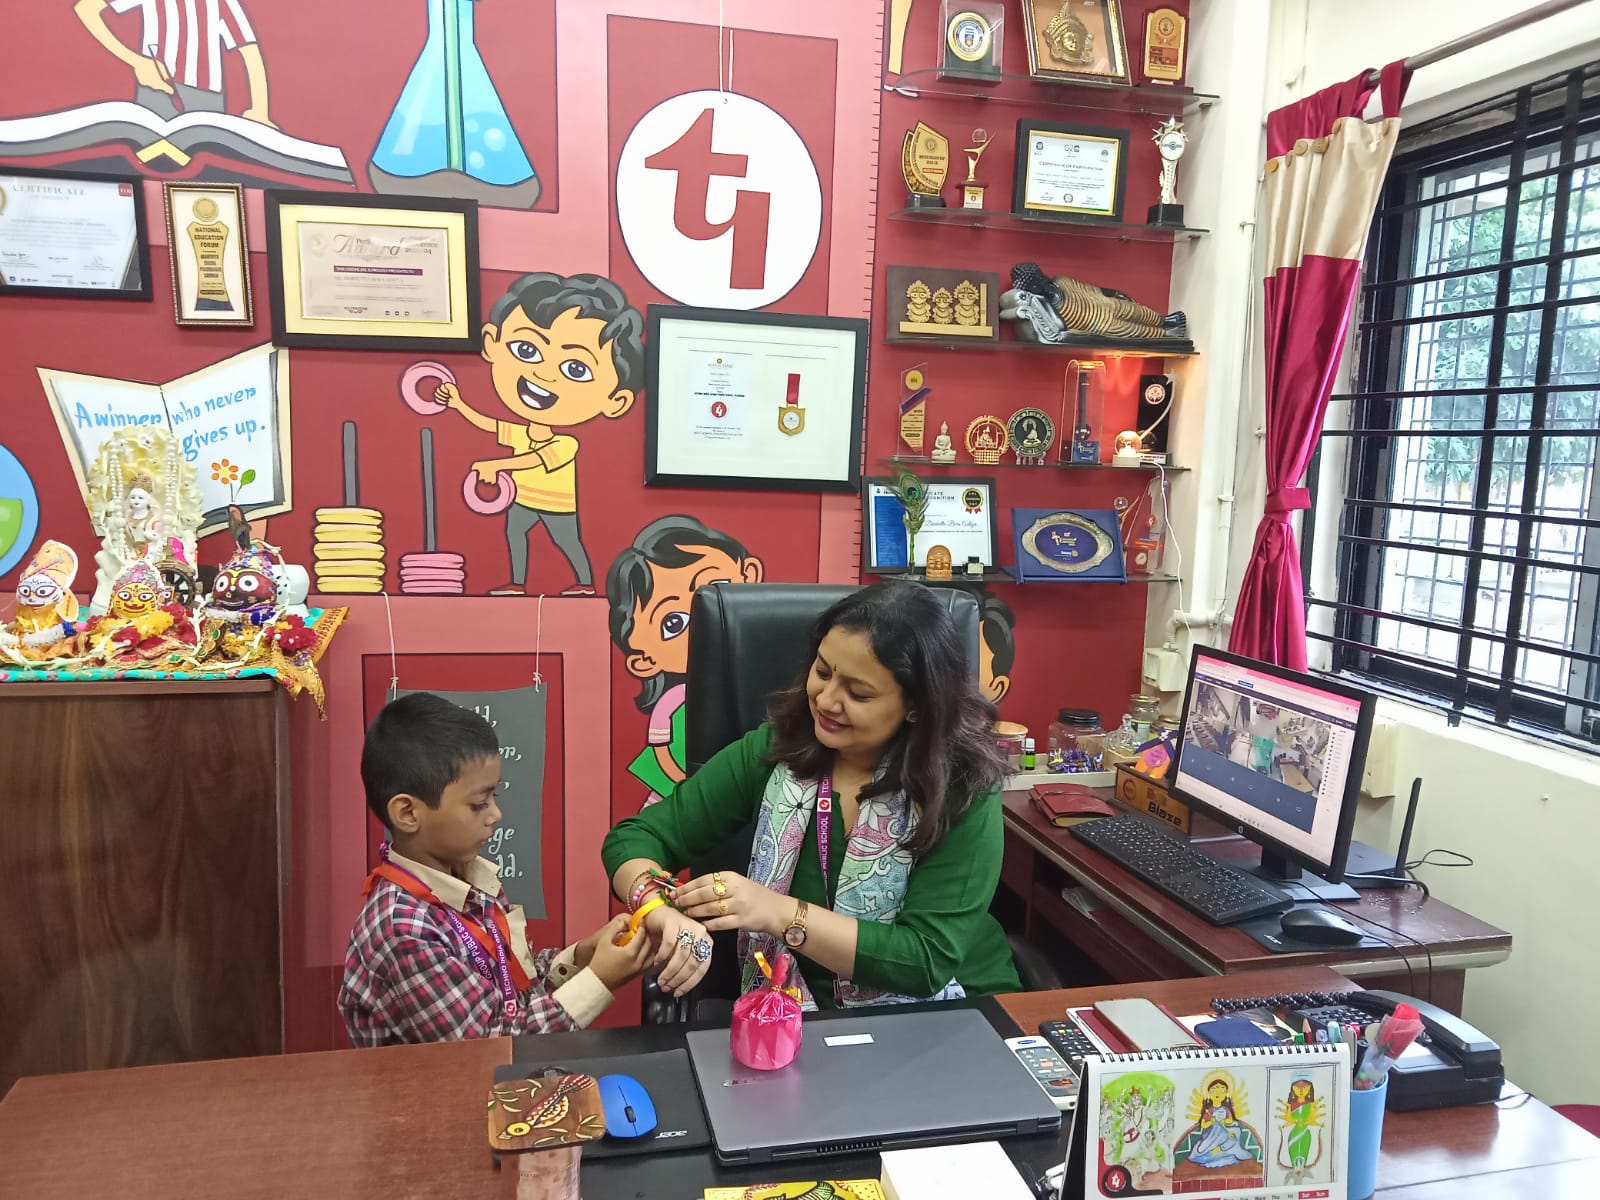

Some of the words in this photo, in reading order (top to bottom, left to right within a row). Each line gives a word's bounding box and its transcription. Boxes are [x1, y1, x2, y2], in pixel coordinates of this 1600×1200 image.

[75, 401, 93, 429] A
[171, 400, 201, 425] who
[204, 386, 257, 409] never
[182, 424, 228, 462] gives
[235, 418, 266, 442] up.
[1148, 801, 1182, 826] Blaze
[461, 931, 481, 957] PUBLIC
[498, 944, 507, 966] INDIA
[502, 966, 512, 996] TECHNO
